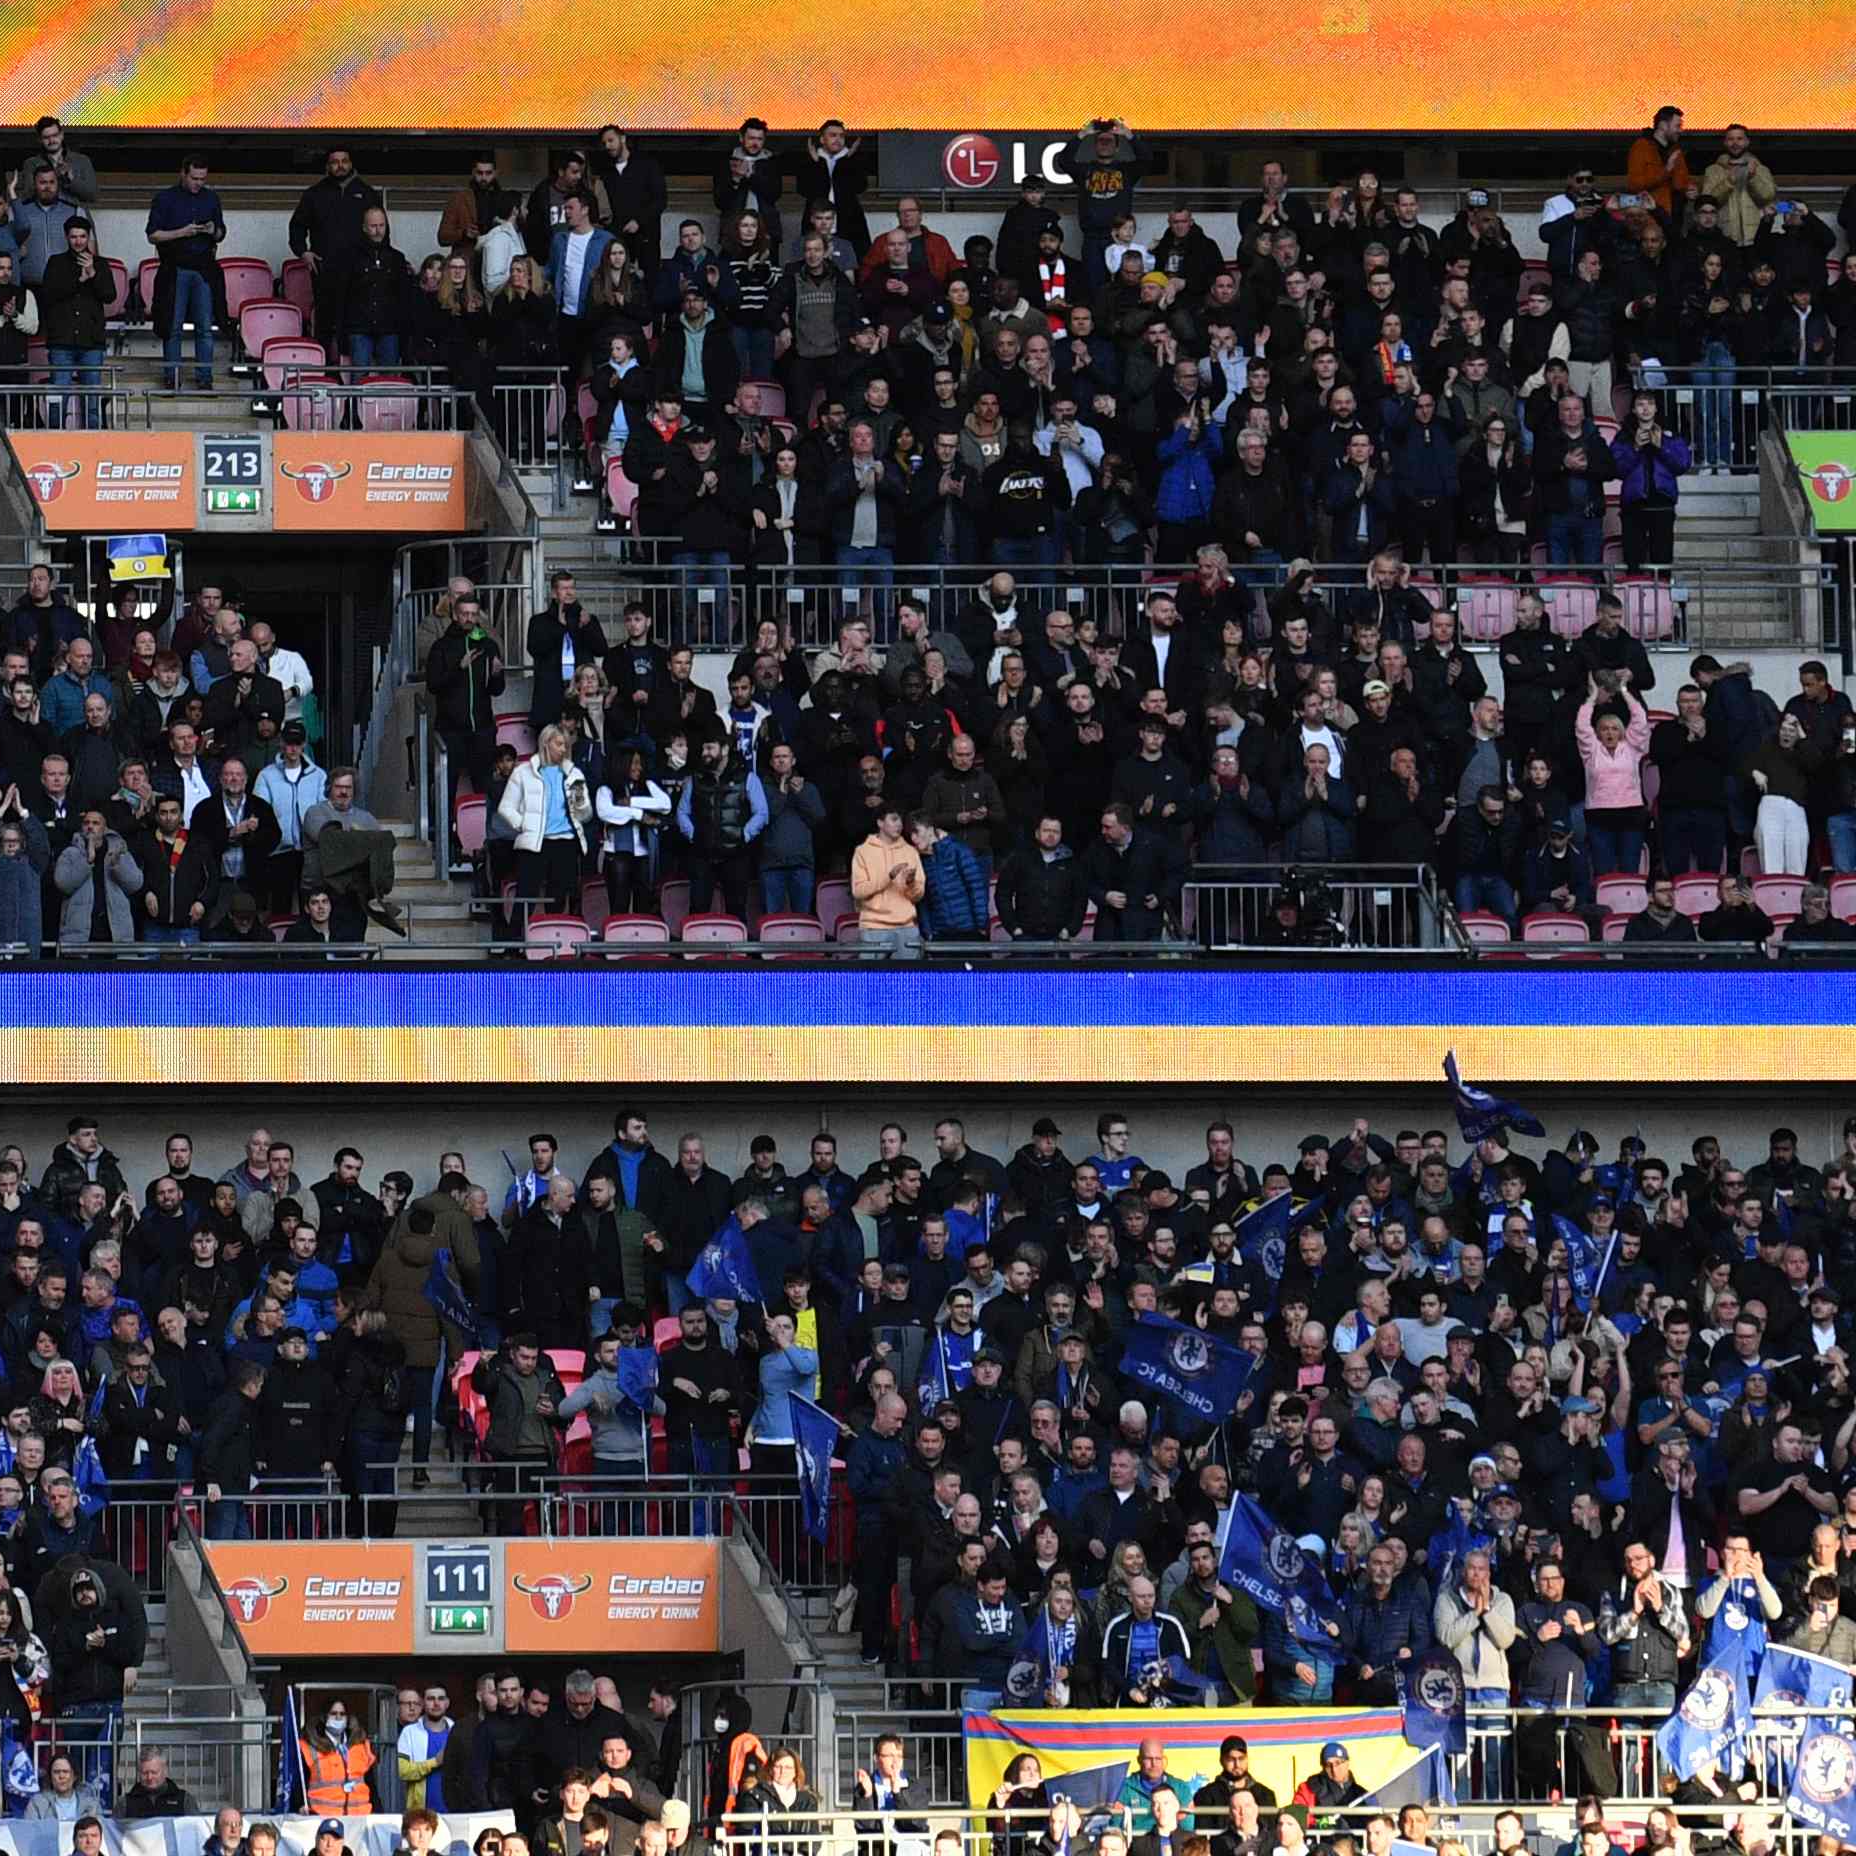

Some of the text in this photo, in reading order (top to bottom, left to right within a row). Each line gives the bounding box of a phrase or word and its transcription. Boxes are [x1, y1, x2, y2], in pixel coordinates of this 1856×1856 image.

[96, 461, 183, 480] Carabao
[207, 452, 258, 477] 213
[367, 462, 453, 481] Carabao
[95, 490, 180, 502] ENERGY DRINK
[366, 490, 450, 502] ENERGY DRINK
[305, 1577, 402, 1597] Carabao
[433, 1564, 485, 1593] 111
[609, 1575, 705, 1595] Carabao
[304, 1608, 396, 1621] ENERGY DRINK
[608, 1606, 700, 1620] ENERGY DRINK
